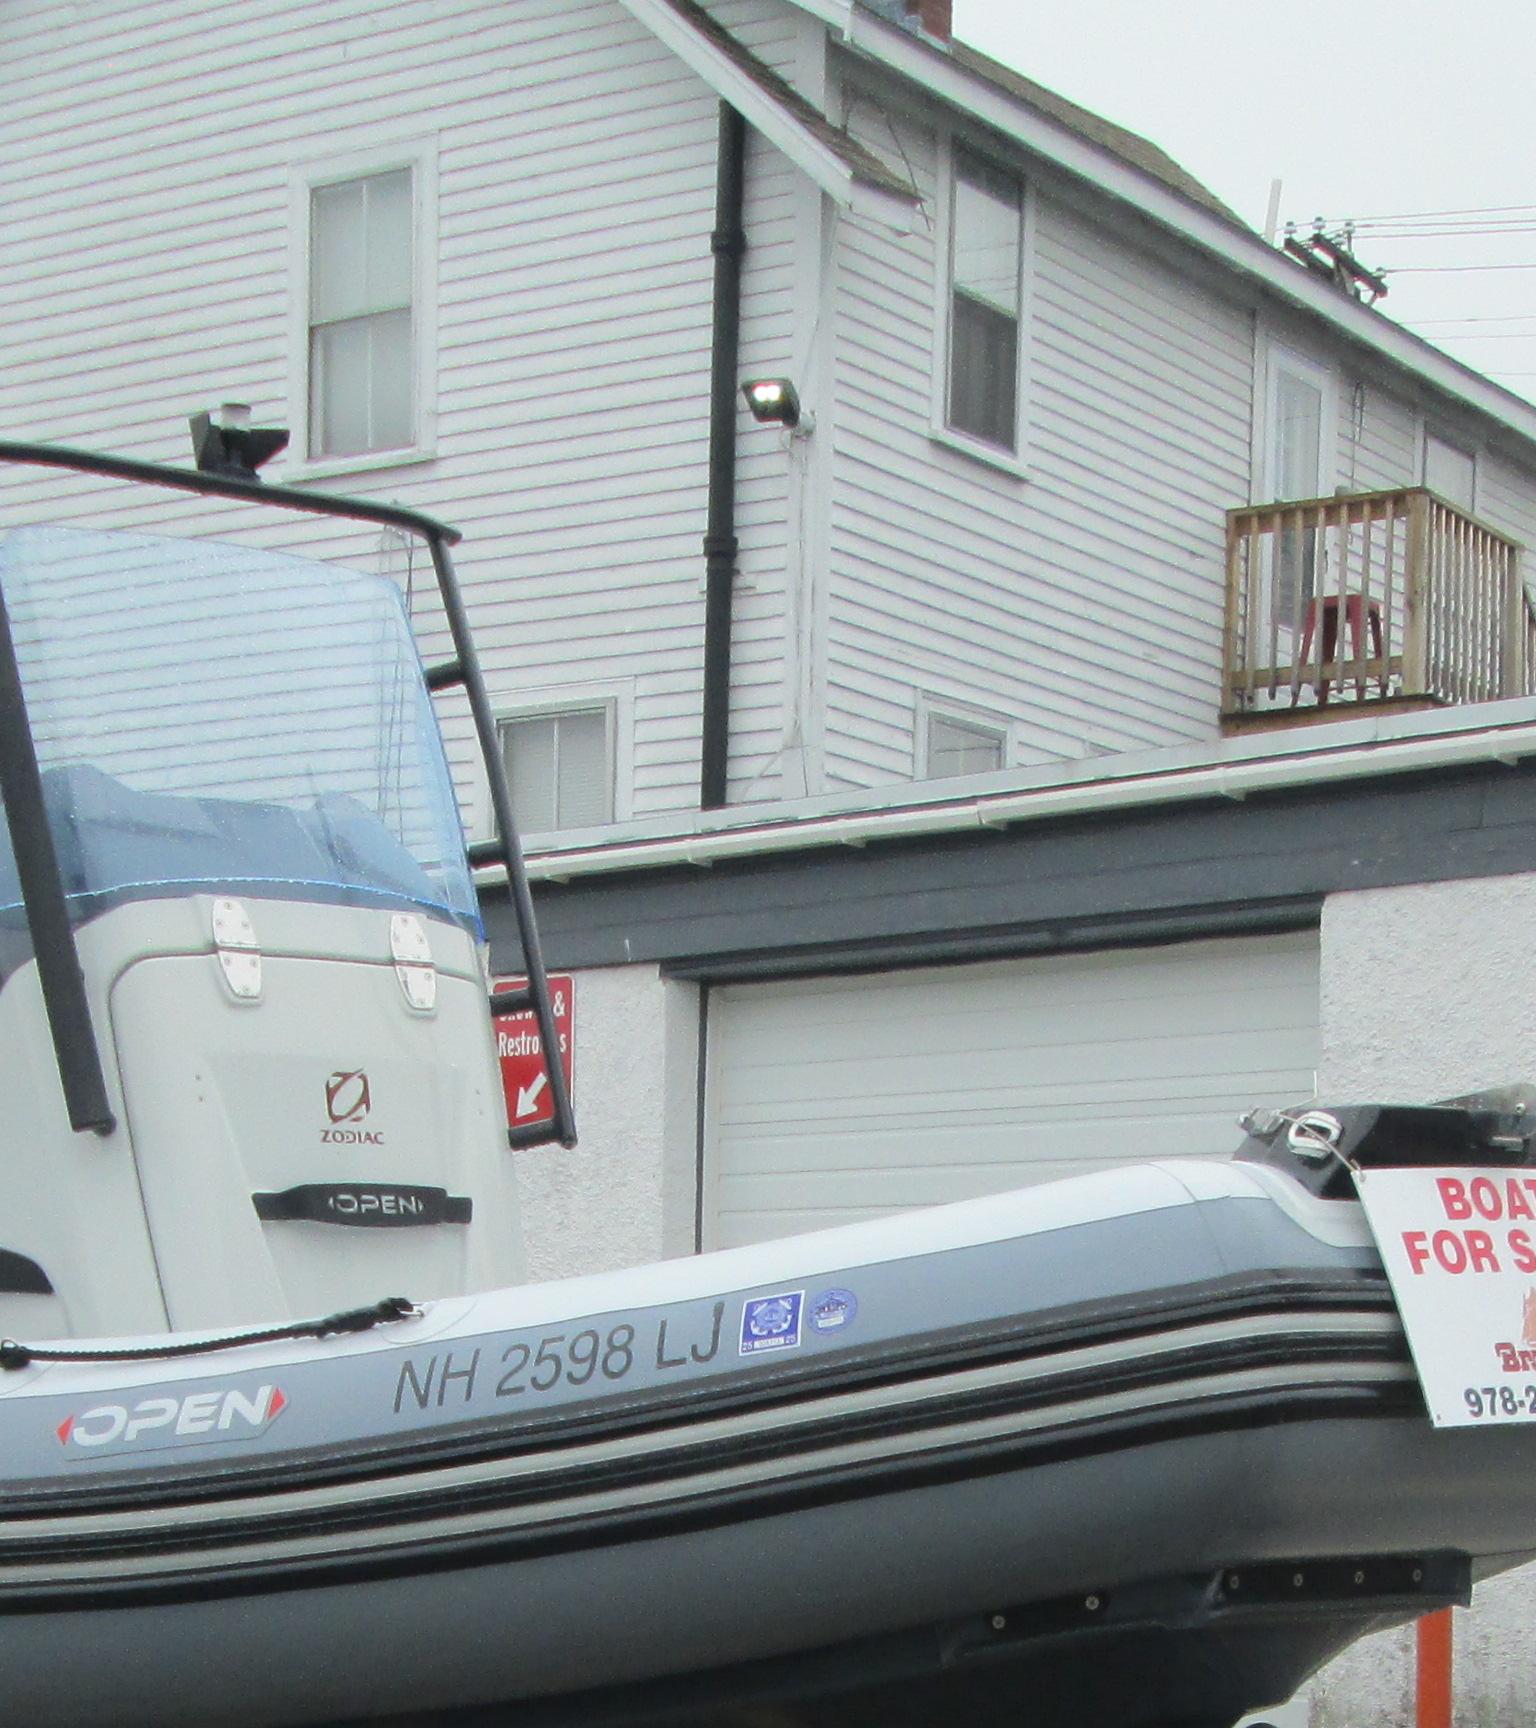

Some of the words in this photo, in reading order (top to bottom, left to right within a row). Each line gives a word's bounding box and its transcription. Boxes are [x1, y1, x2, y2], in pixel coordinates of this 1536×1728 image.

[553, 990, 566, 1017] &
[499, 1030, 567, 1057] Restros
[321, 1129, 384, 1145] ZODIAC
[332, 1194, 420, 1215] OPEN
[1401, 1229, 1502, 1275] FOR
[394, 1348, 479, 1414] NH
[496, 1324, 634, 1399] 2598
[656, 1303, 725, 1370] LJ
[72, 1385, 273, 1448] OPEN
